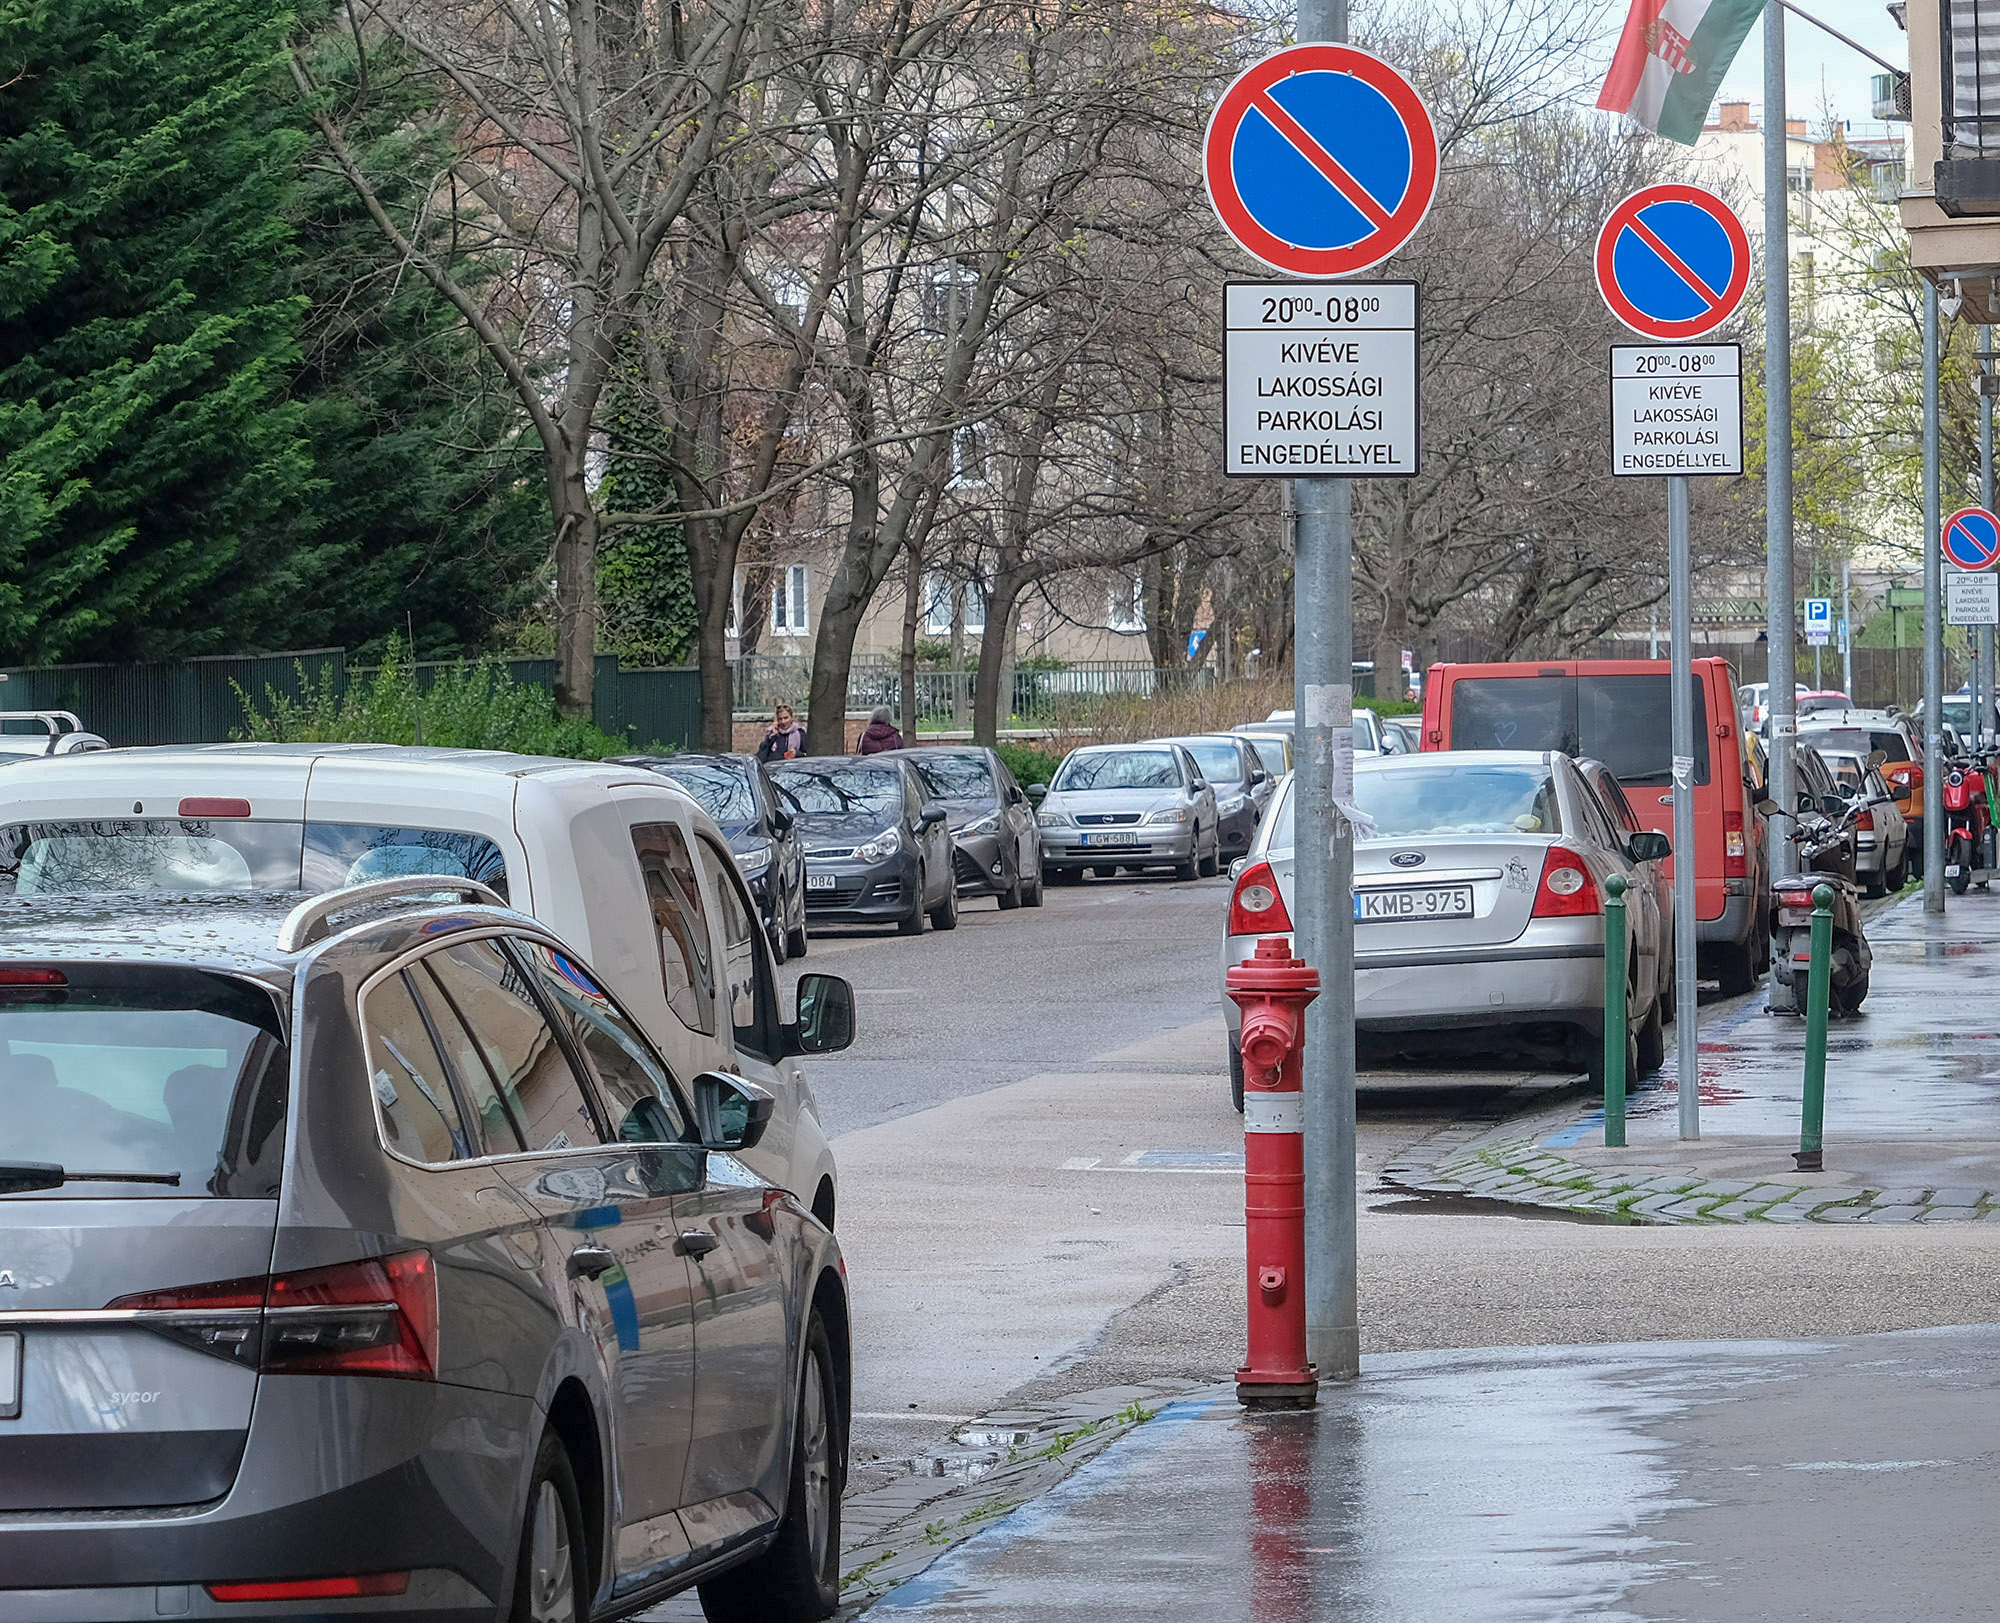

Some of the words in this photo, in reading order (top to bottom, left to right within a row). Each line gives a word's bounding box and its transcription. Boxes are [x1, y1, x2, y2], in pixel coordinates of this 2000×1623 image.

[1281, 337, 1360, 363] KIVÉVE
[1257, 371, 1383, 397] LAKOSSÁGI
[1649, 381, 1702, 400] KIVÉVE
[1257, 405, 1383, 431] PARKOLÁSI
[1633, 404, 1719, 423] LAKOSSÁGI
[1633, 427, 1719, 446] PARKOLÁSI
[1240, 438, 1402, 465] ENGEDÉLLYEL
[1622, 450, 1732, 469] ENGEDÉLLYEL
[1812, 603, 1824, 619] P
[806, 876, 833, 888] -084
[1365, 891, 1466, 916] KMB-975
[110, 1391, 161, 1406] sycor
